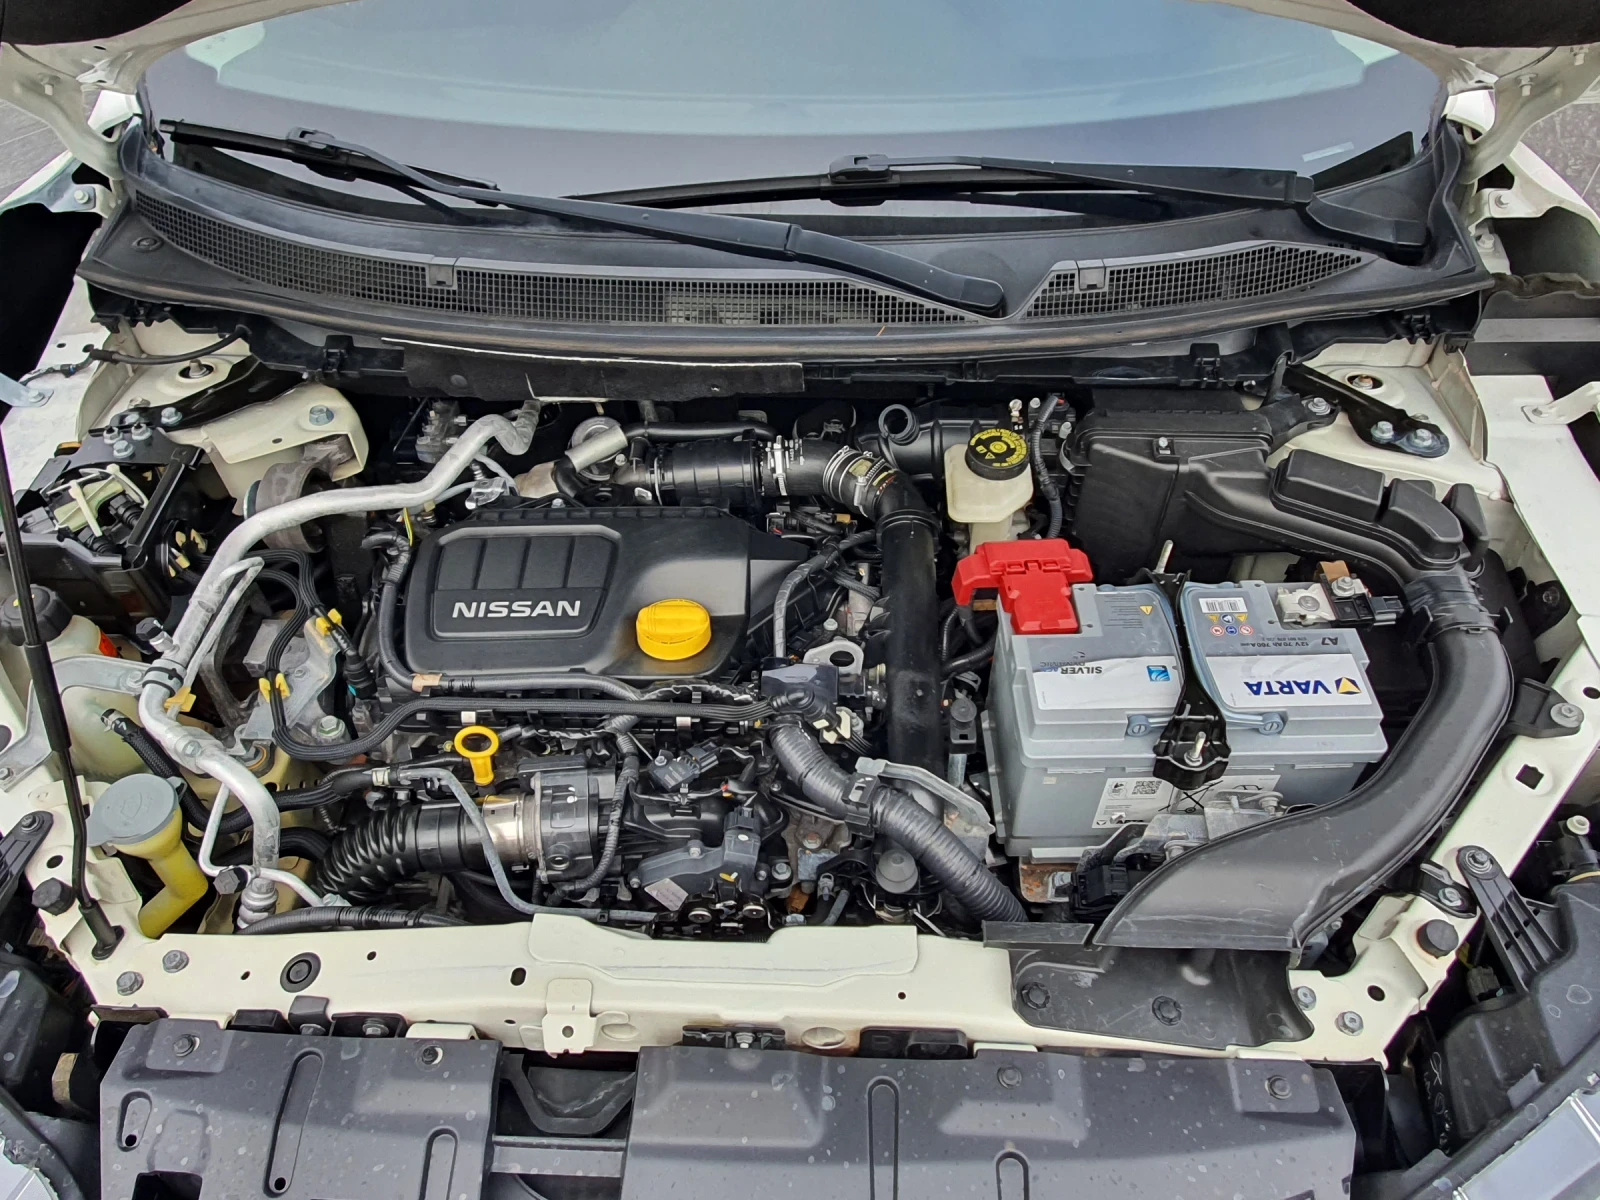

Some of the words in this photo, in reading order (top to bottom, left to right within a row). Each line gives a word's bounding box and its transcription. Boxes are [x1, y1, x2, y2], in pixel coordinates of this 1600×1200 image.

[452, 600, 581, 618] NISSAN
[1321, 637, 1338, 646] A7
[1060, 666, 1103, 675] SILVER
[1243, 680, 1332, 695] VARTA
